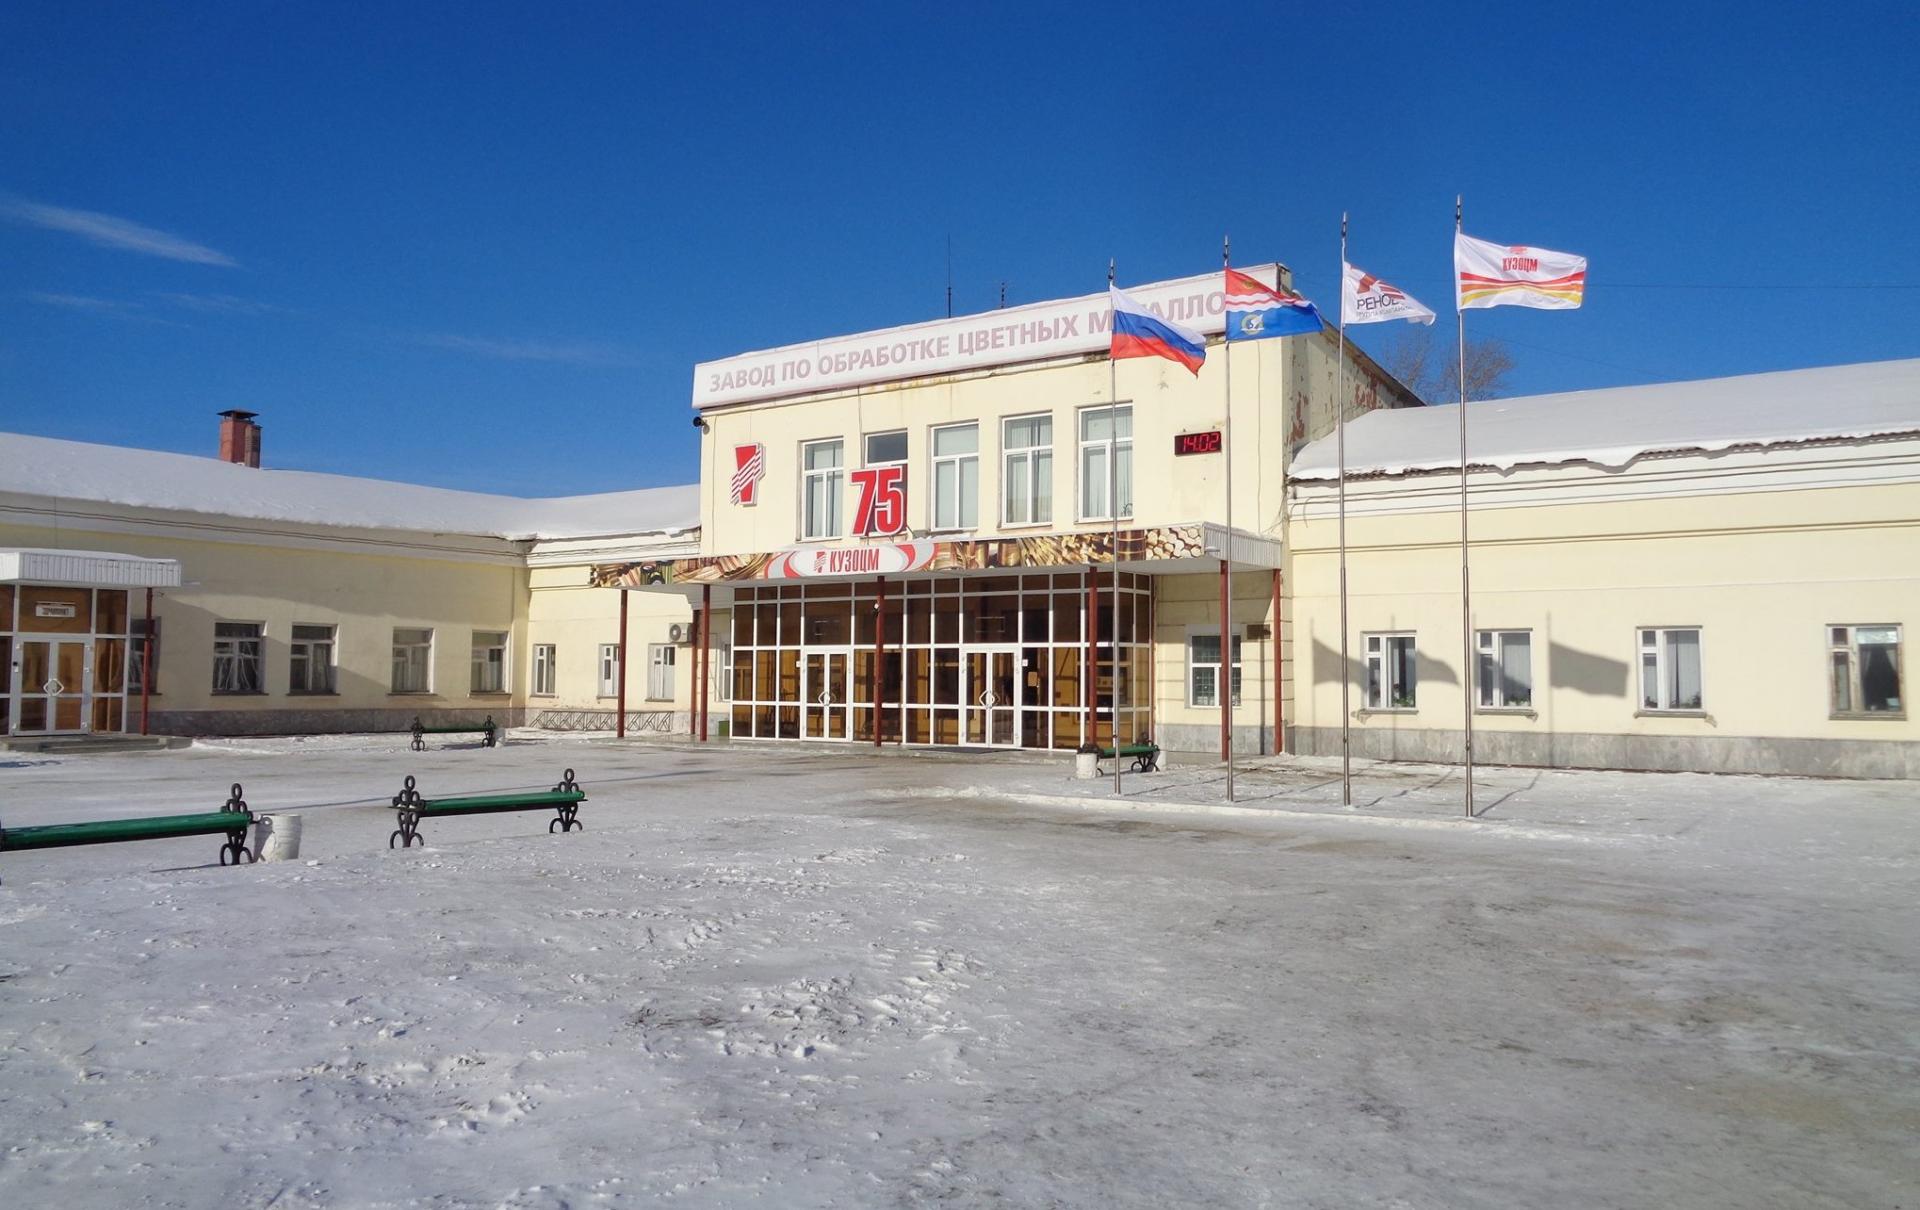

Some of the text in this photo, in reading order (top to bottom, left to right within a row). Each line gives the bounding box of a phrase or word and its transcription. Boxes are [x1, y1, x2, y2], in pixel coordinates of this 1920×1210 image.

[1503, 257, 1538, 272] КУЗОЦМ
[709, 291, 1226, 392] ЗАВОД ПО ОБРАБОТКЕ ЦВЕТНЫХ МАЛЛО
[850, 466, 904, 536] 75
[829, 548, 880, 573] КУЗОЦМ
